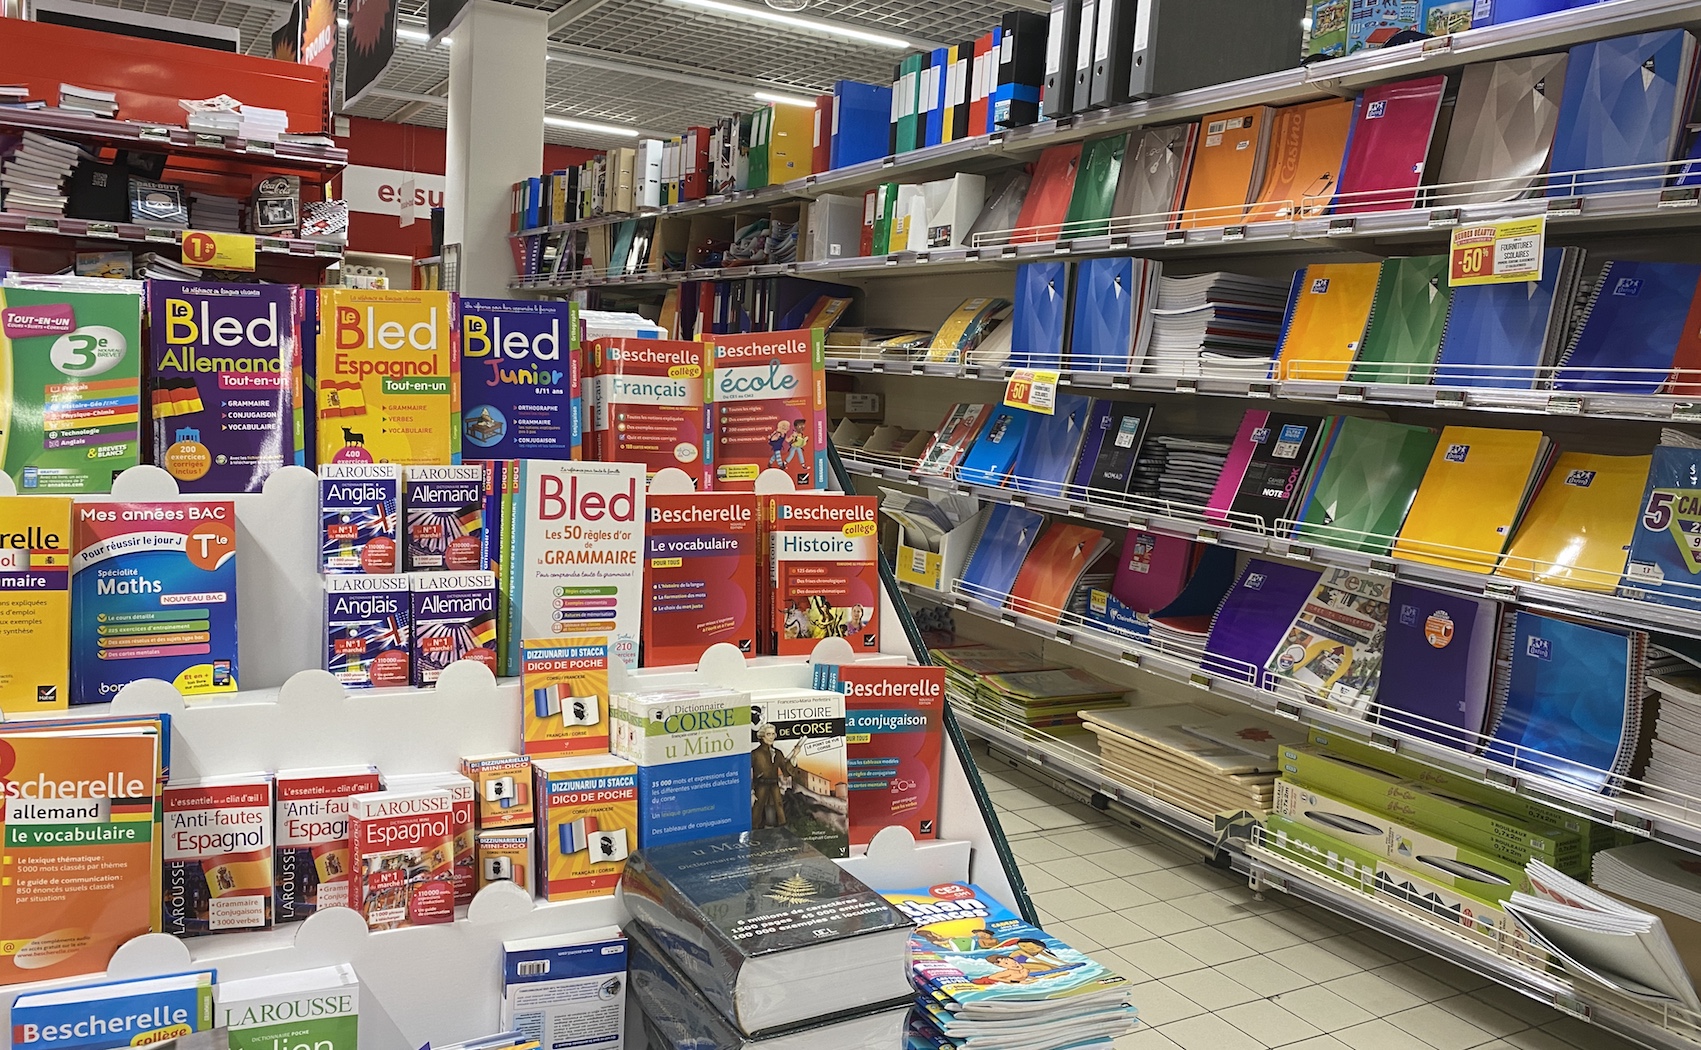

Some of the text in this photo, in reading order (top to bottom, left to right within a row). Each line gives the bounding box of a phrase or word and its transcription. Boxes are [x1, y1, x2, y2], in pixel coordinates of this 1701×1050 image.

[306, 24, 332, 65] PROMO
[1282, 114, 1301, 184] Casino
[1500, 240, 1533, 251] FOURNITURES
[1504, 250, 1530, 260] SCOLAIRES
[166, 298, 278, 348] Bled
[336, 306, 437, 350] Bled
[464, 315, 560, 360] Bled
[612, 348, 700, 364] Bescherelle
[718, 340, 806, 358] Bescherelle
[334, 354, 438, 381] Espagnol
[484, 358, 564, 386] Junior
[670, 367, 700, 377] collège
[223, 376, 288, 386] Tout-en-un
[720, 358, 799, 394] école
[386, 381, 446, 392] Tout-en-un
[614, 378, 686, 400] Français
[60, 410, 115, 419] Physique-Chimie
[518, 404, 558, 412] ORTHOGRAPHE
[60, 428, 100, 437] Technologie
[60, 438, 86, 446] Anglais
[180, 446, 196, 454] 200
[326, 466, 394, 478] LAROUSSE
[411, 468, 478, 480] LAROUSSE
[1104, 472, 1123, 480] NOMAD
[327, 483, 386, 505] Anglais
[412, 484, 478, 502] Allemand
[538, 474, 636, 522] Bled
[80, 507, 226, 522] Mes années BAC
[650, 504, 751, 522] Bescherelle
[783, 504, 874, 520] Bescherelle
[1643, 491, 1676, 532] 5
[545, 526, 632, 542] Les 50 règles d'or
[844, 523, 875, 534] collège
[651, 538, 738, 552] Le vocabulaire
[784, 536, 854, 552] Histoire
[544, 550, 636, 564] GRAMMAIRE
[98, 568, 138, 578] Spécialité
[98, 576, 162, 596] Maths
[334, 578, 406, 591] LAROUSSE
[420, 575, 492, 590] LAROUSSE
[163, 595, 204, 603] NOUVEAU
[334, 596, 398, 618] Anglais
[421, 593, 492, 614] Allemand
[6, 608, 36, 616] d'emploi
[10, 618, 42, 626] exemples
[526, 648, 604, 660] DIZZIUNARIU DI STACCA
[616, 642, 632, 650] 210
[527, 659, 603, 671] DICO DE POCHE
[844, 680, 940, 697] Bescherelle
[674, 702, 724, 714] Dictionnaire
[777, 706, 832, 720] HISTOIRE
[664, 708, 735, 734] CORSE
[780, 722, 832, 736] DE CORSE
[858, 714, 927, 730] conjugaison
[481, 762, 528, 772] MINI-DICO
[0, 772, 144, 800] scherelle
[552, 777, 634, 793] DIZZIUNARIU DI STACCA
[552, 790, 634, 805] DICO DE POCHE
[13, 803, 99, 820] allemand
[366, 797, 449, 818] LAROUSSE
[171, 810, 262, 829] L'Anti-fautes
[12, 826, 136, 843] le vocabulaire
[367, 815, 449, 846] Espagnol
[171, 826, 264, 854] d'Espagnol
[28, 857, 56, 865] lexique
[32, 886, 63, 894] énoncés
[65, 884, 88, 892] usuels
[282, 848, 296, 918] LAROUSSE
[934, 885, 962, 896] CE2
[16, 896, 28, 904] par
[172, 860, 186, 935] LAROUSSE
[216, 900, 258, 908] Grammaire
[216, 908, 262, 917] Conjugaisons
[737, 918, 745, 926] 6
[747, 911, 789, 924] millions
[805, 898, 858, 912] caractères
[895, 899, 988, 918] than
[732, 932, 753, 940] 100
[755, 928, 776, 936] 000
[778, 917, 828, 932] exemples
[842, 904, 888, 920] locutions
[224, 994, 353, 1027] LAROUSSE
[22, 1006, 188, 1044] Bescherelle
[252, 1032, 290, 1042] DICTIONNAIRE
